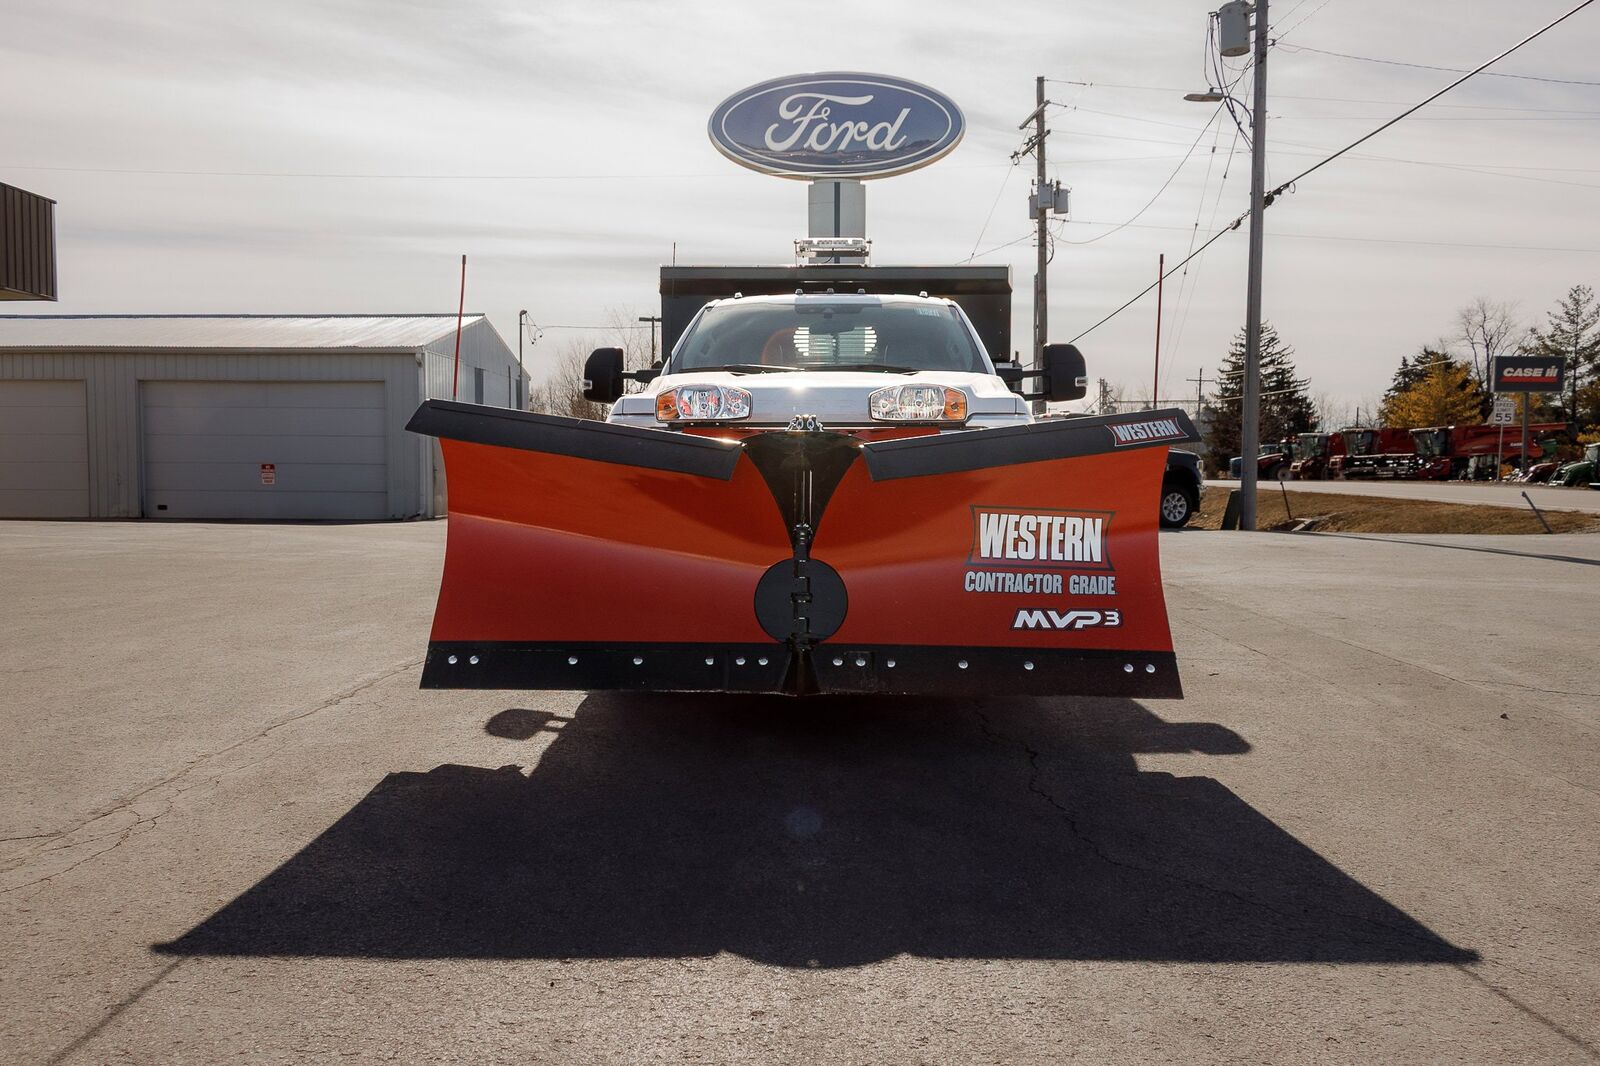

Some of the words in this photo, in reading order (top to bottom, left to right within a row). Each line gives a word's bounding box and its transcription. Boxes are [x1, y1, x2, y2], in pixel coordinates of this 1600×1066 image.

[765, 93, 911, 151] Ford
[1503, 367, 1543, 377] CASE
[1495, 413, 1512, 421] 55
[1113, 419, 1180, 442] WESTERN
[979, 513, 1103, 562] WESTERN
[964, 571, 1062, 594] CONTRACTOR
[1069, 576, 1117, 595] GRADE
